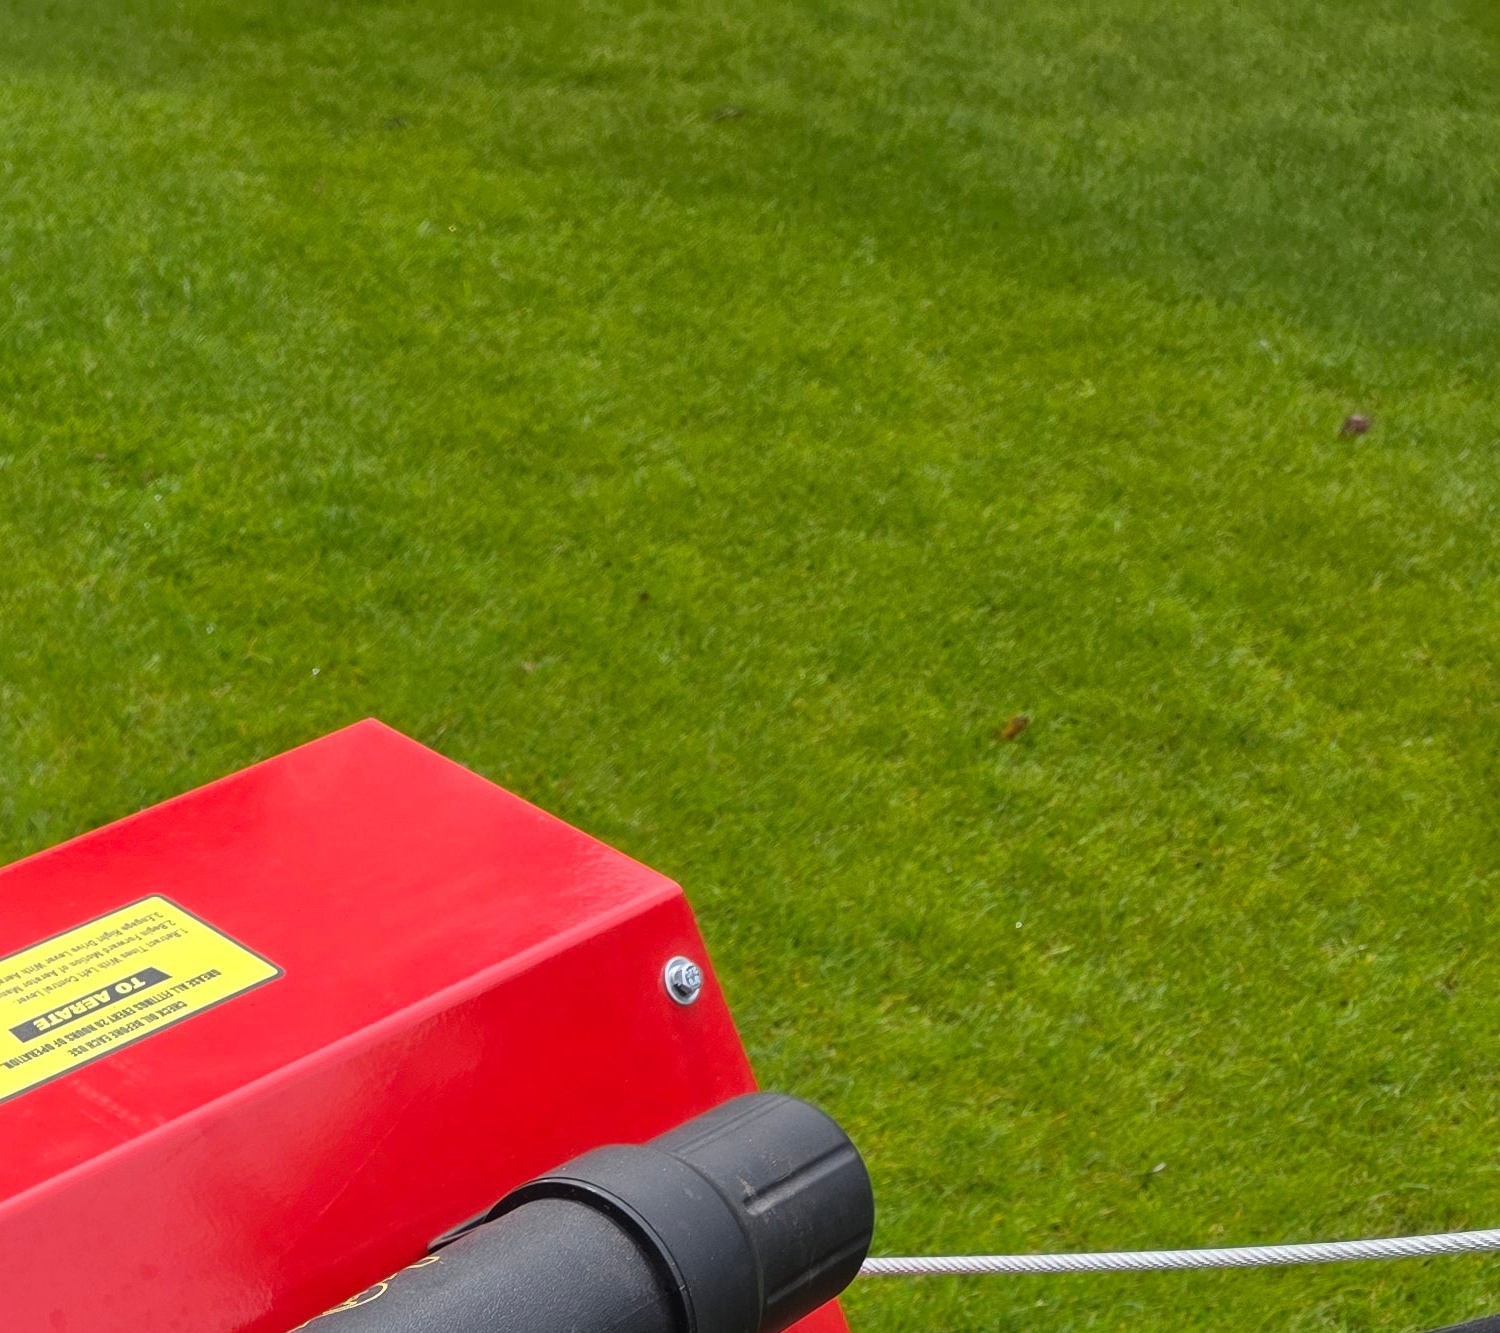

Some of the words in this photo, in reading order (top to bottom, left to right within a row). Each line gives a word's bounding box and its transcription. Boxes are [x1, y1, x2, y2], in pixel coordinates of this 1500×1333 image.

[95, 929, 124, 942] Right
[70, 940, 99, 952] Drive
[102, 934, 143, 954] Forward
[45, 951, 73, 964] Lever
[69, 951, 105, 967] Motion
[97, 957, 123, 969] With
[20, 962, 47, 974] With
[77, 966, 100, 978] Left
[22, 969, 59, 988] Aerator
[42, 975, 79, 994] Control
[169, 983, 190, 994] ALL
[33, 990, 110, 1031] AERATE
[140, 1013, 160, 1023] OIL
[108, 1019, 145, 1039] BEFORE
[85, 1034, 113, 1049] EACH
[67, 1045, 89, 1057] USE
